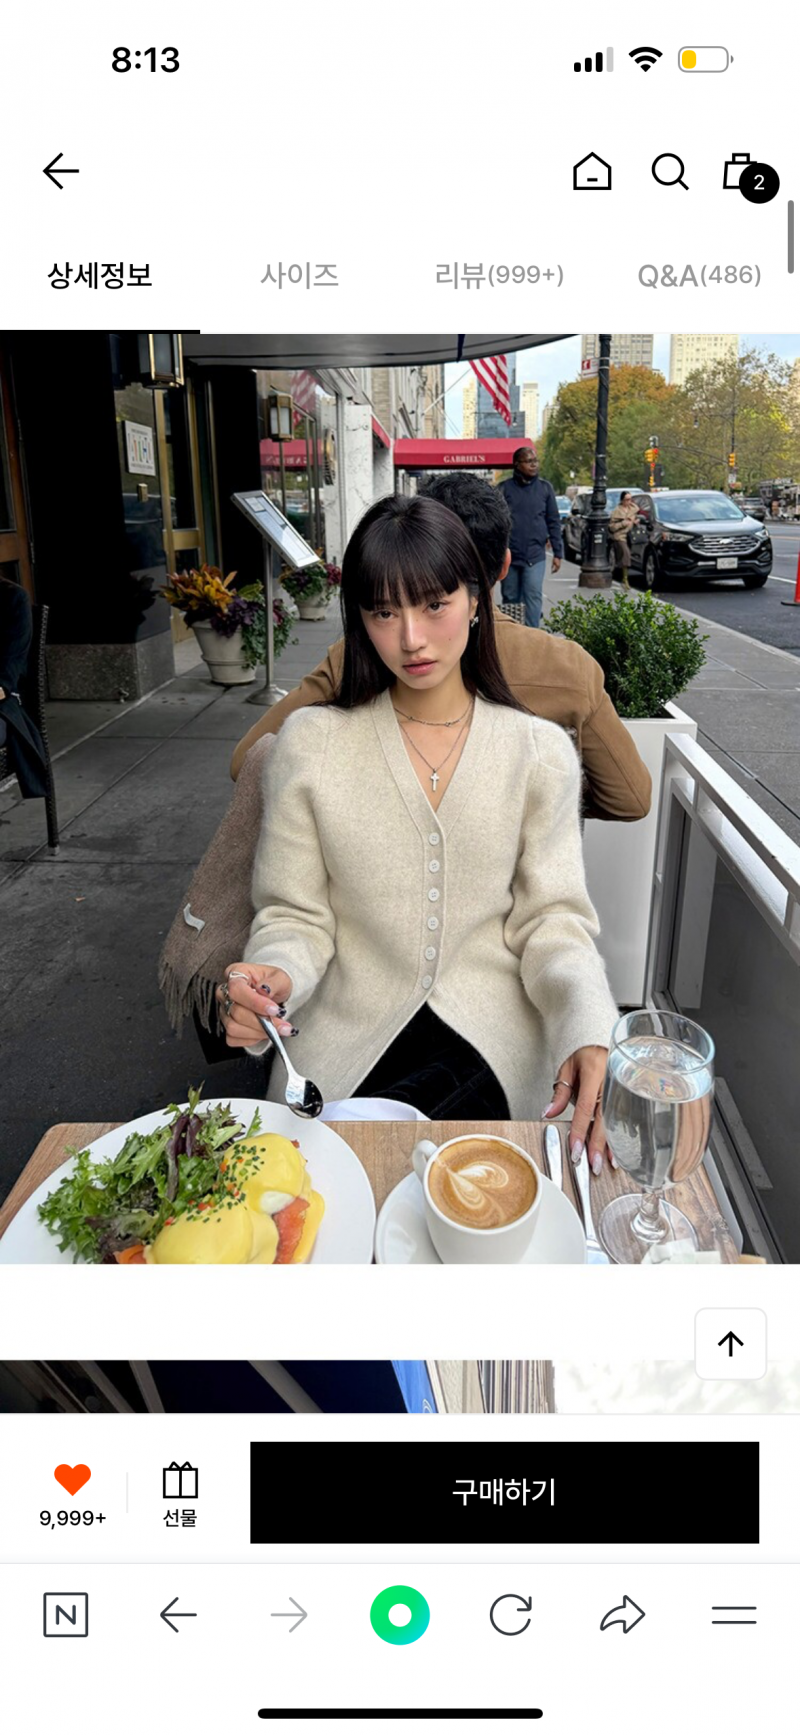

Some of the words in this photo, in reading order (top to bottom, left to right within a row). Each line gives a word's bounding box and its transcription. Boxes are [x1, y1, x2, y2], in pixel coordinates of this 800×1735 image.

[111, 46, 181, 74] 8:13
[753, 174, 765, 190] 2
[46, 261, 153, 290] 상세정보
[260, 261, 339, 290] 사이즈
[435, 261, 564, 290] 리뷰(999+)
[637, 262, 762, 290] Q&A(486)
[443, 455, 486, 464] GABRIEL'S
[452, 1478, 556, 1507] 구매하기
[39, 1509, 107, 1531] 9,999+
[162, 1508, 198, 1528] 선물
